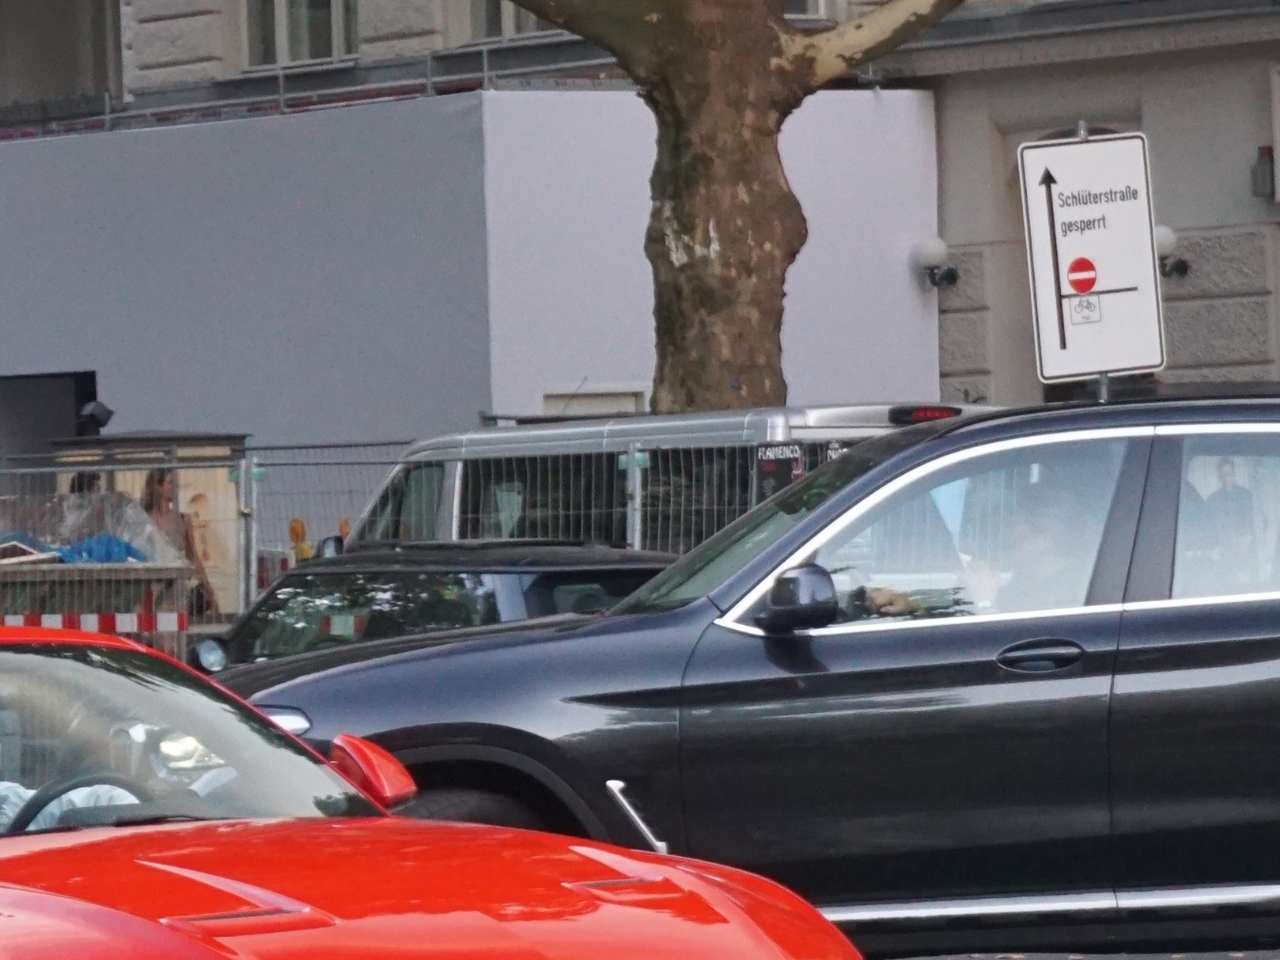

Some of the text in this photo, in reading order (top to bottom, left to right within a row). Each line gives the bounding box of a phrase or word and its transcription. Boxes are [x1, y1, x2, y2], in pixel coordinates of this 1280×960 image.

[1058, 185, 1138, 208] Schlüterstraße
[1060, 214, 1107, 237] gesperrt
[757, 445, 801, 460] FLAMENCO
